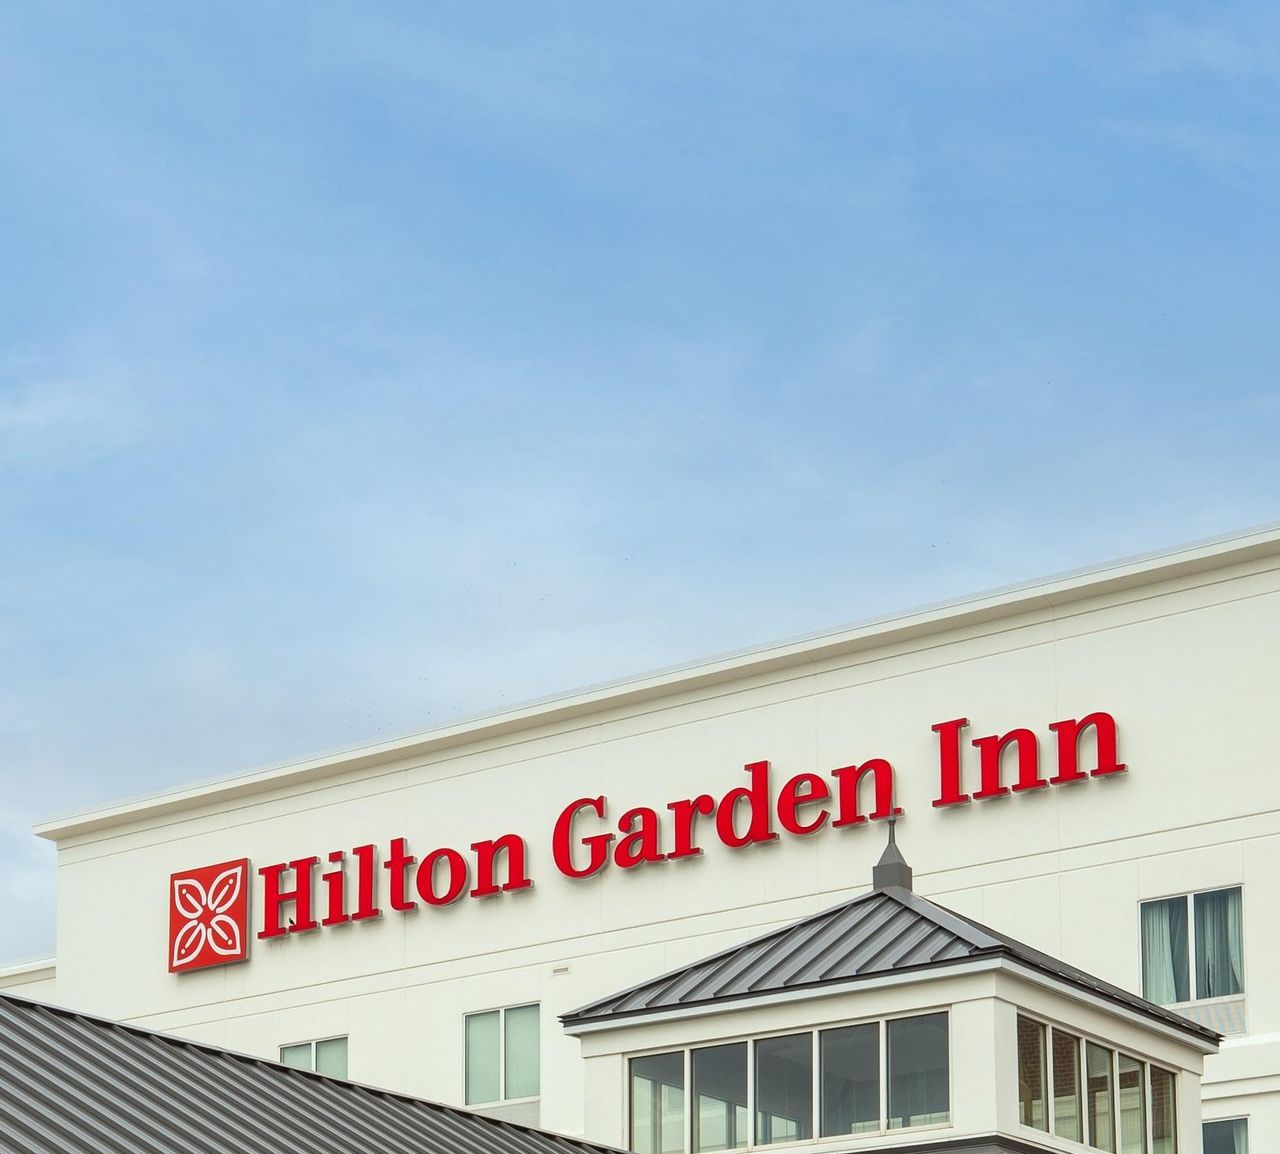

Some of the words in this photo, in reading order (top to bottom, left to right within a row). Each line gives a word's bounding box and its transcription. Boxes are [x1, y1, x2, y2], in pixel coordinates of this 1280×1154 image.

[257, 834, 532, 940] Hilton
[552, 759, 903, 880] Garden
[931, 712, 1127, 808] Inn
